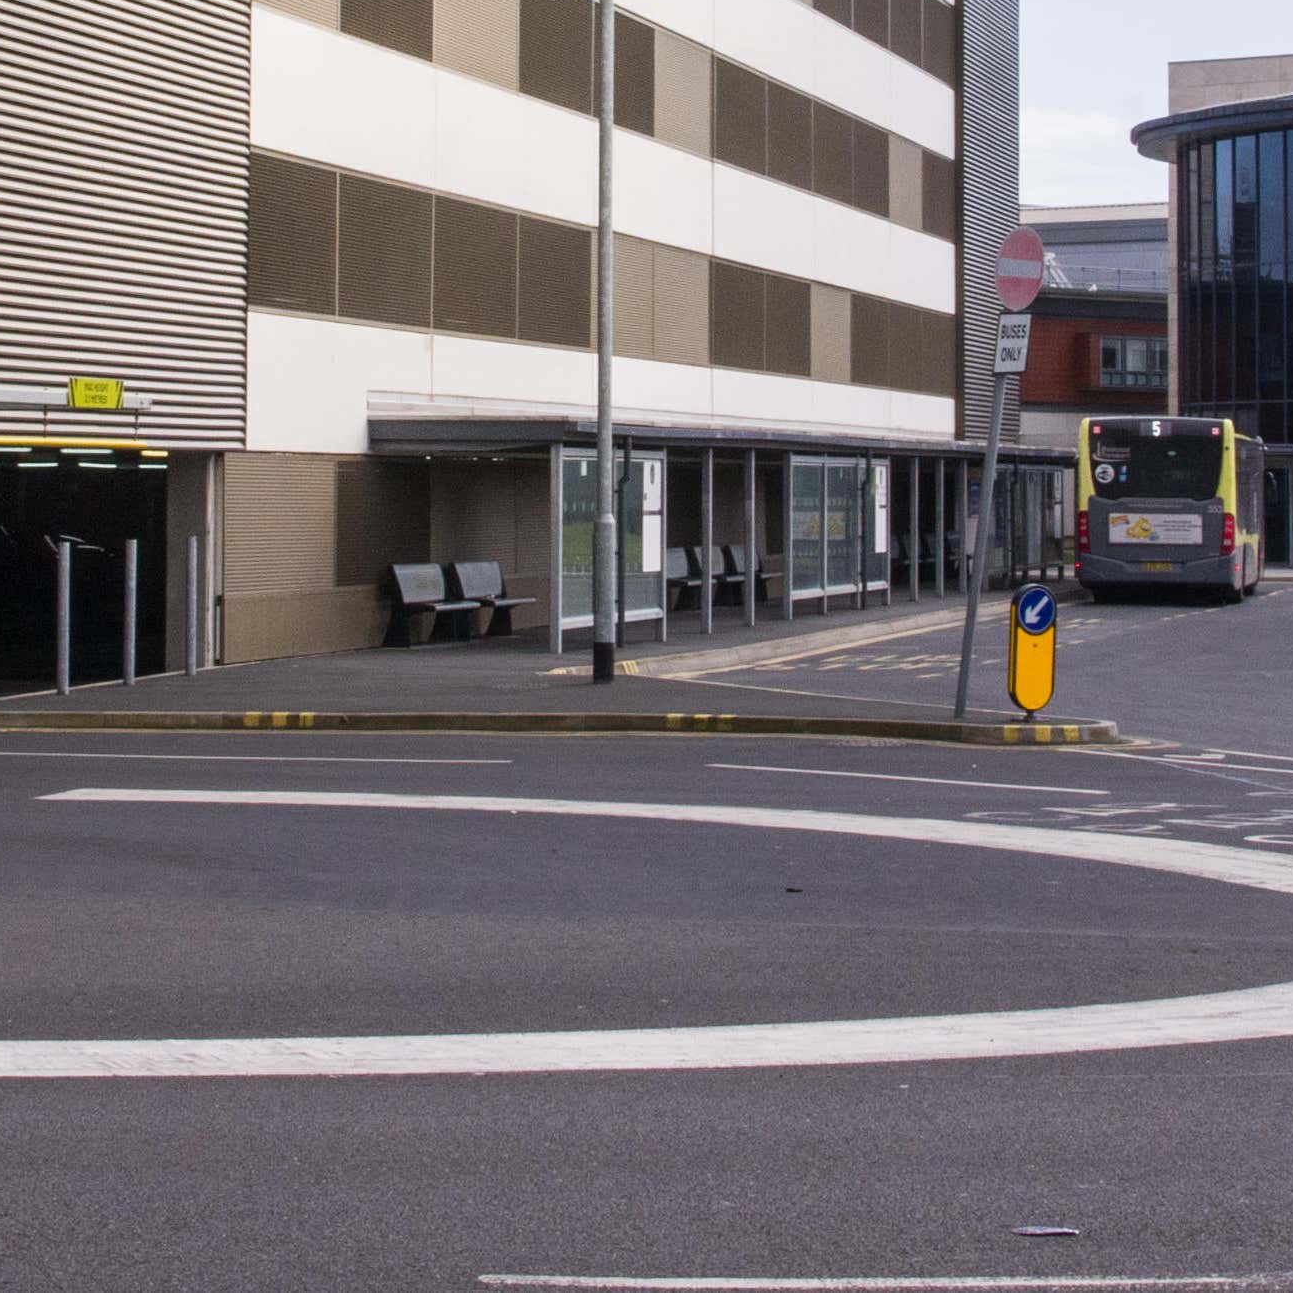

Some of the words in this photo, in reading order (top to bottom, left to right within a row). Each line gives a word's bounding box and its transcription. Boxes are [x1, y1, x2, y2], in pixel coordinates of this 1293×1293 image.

[1000, 323, 1027, 339] BUSES
[1000, 346, 1023, 362] ONLY
[1151, 420, 1162, 437] 5
